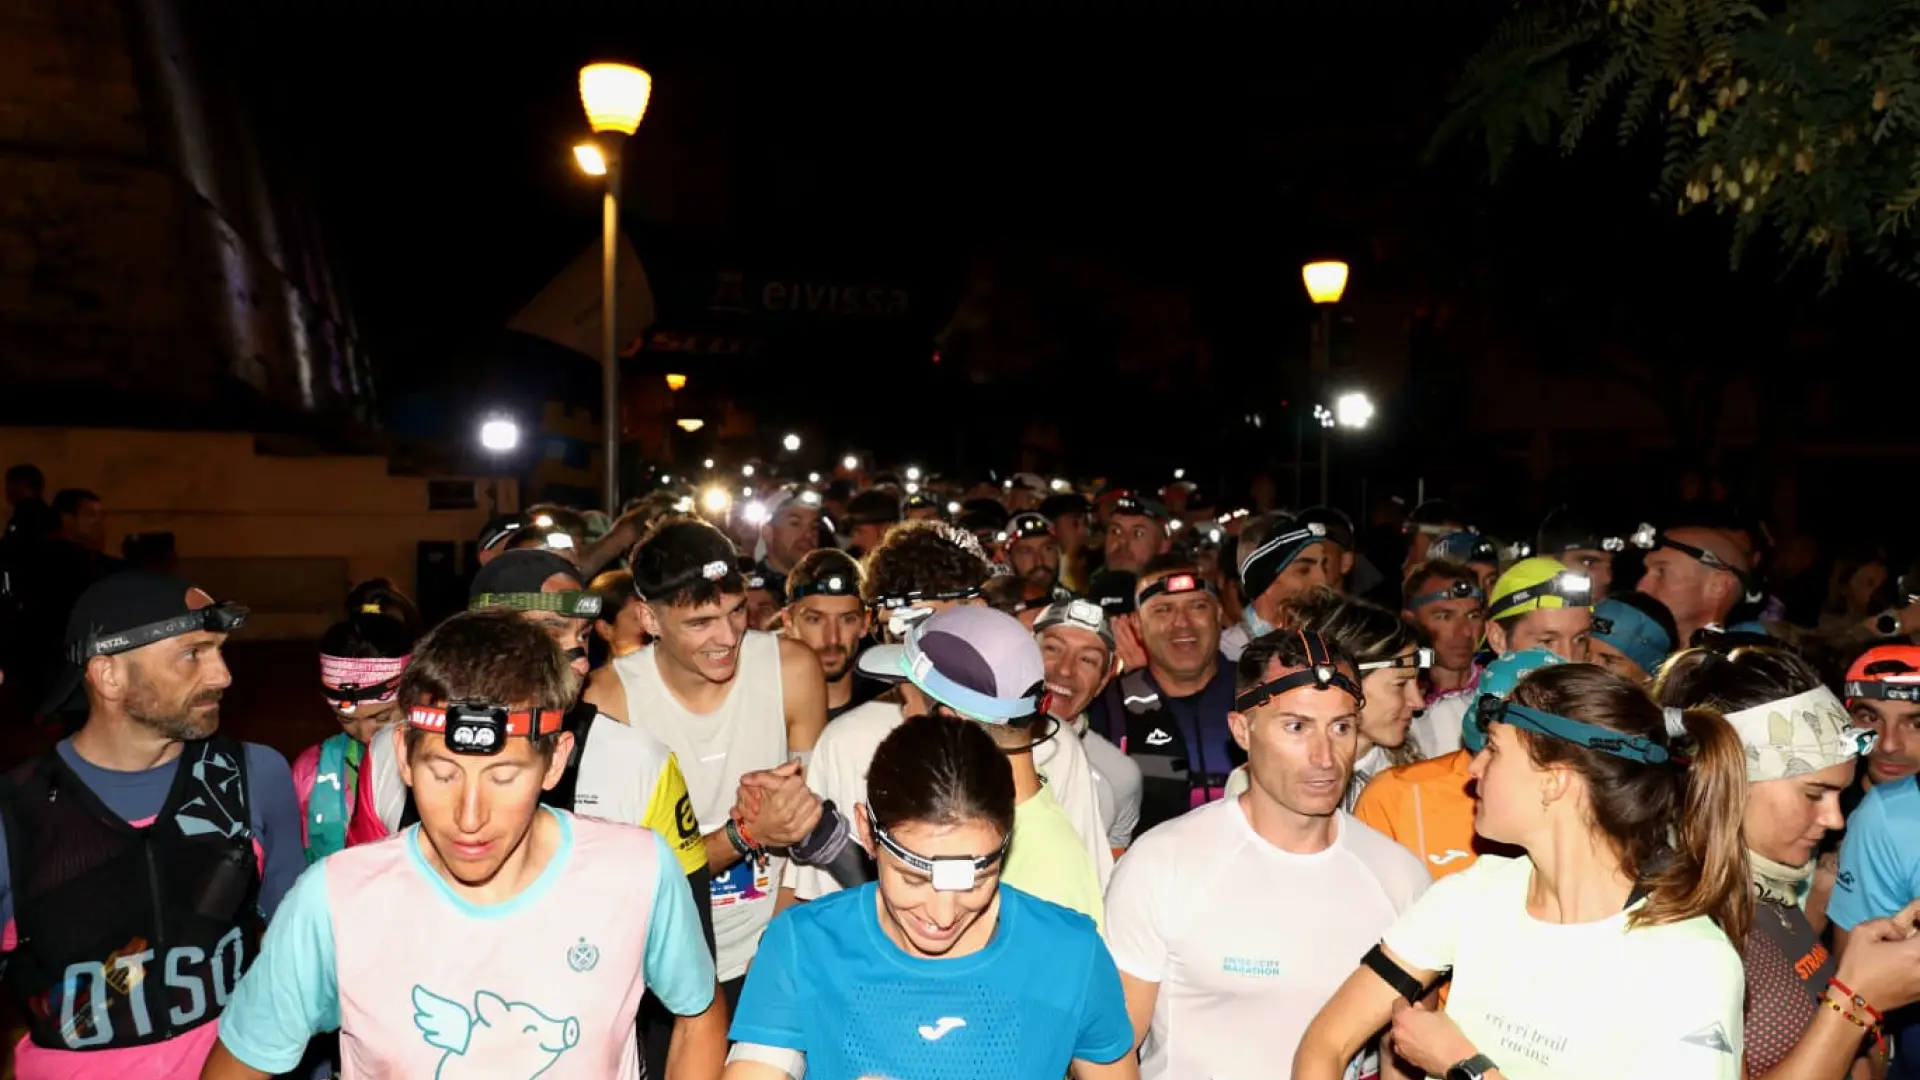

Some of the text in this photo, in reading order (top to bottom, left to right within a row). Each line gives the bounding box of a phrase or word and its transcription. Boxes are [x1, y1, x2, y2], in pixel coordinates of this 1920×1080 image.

[761, 279, 910, 317] eivissa
[1222, 964, 1280, 976] MARATHON
[1500, 1035, 1550, 1067] racing
[1531, 1028, 1569, 1052] trail
